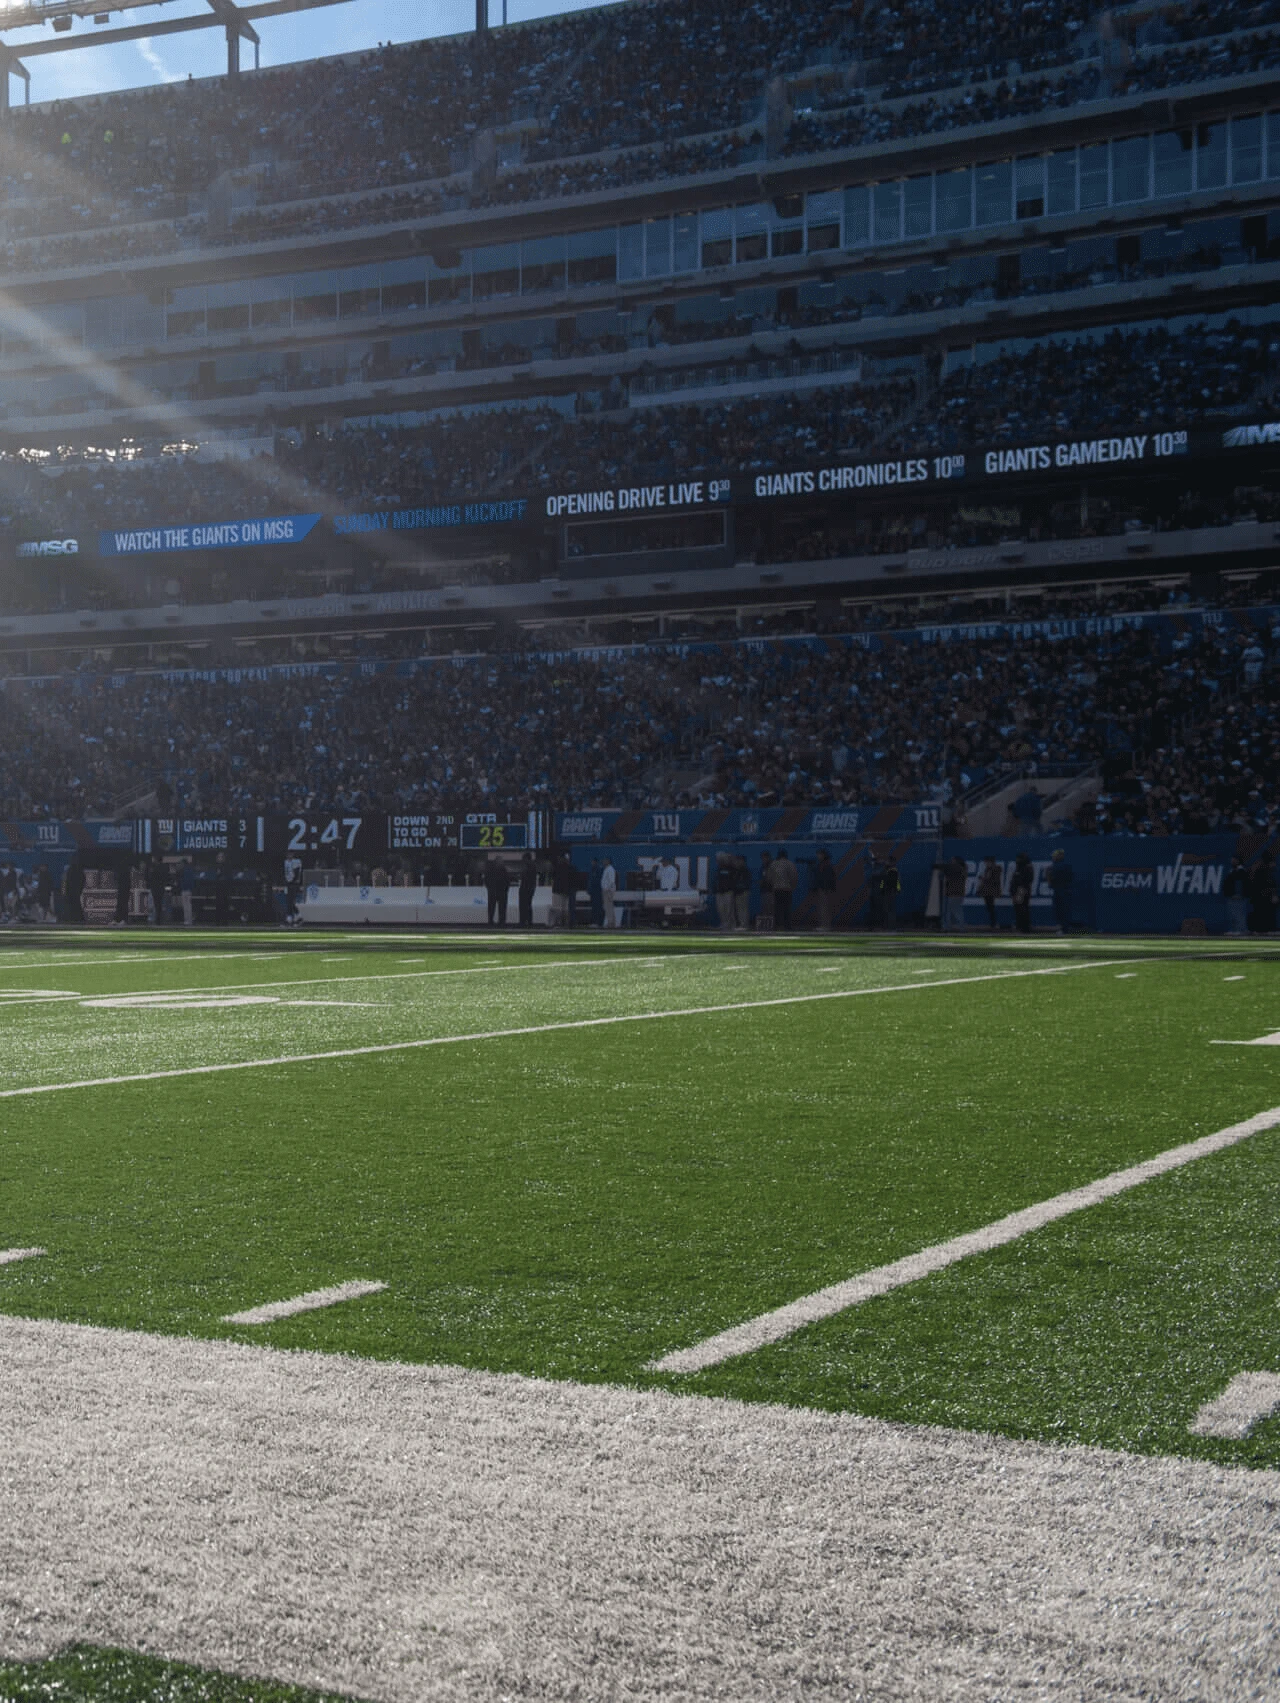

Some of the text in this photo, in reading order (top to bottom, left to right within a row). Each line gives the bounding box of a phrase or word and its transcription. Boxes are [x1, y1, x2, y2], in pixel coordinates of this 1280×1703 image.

[985, 446, 1050, 473] GIANTS
[1056, 435, 1148, 467] GAMEDAY
[755, 472, 814, 497] GIANTS
[819, 459, 928, 490] CHRONICLES
[547, 490, 614, 515] OPENING
[619, 486, 666, 509] DRIVE
[669, 482, 703, 504] LIVE
[333, 500, 528, 535] SUNDAY MORNING KICKOFF
[114, 520, 294, 551] WATCH THE GIANTS ON MSG
[30, 539, 78, 556] MSG
[183, 819, 247, 833] GIANTS 3
[393, 816, 429, 826] DOWN
[465, 813, 497, 824] QTR
[811, 812, 858, 830] GIANTS
[183, 835, 247, 848] JAGUARS 7
[288, 817, 362, 850] 2:47
[393, 827, 408, 837] TO
[410, 827, 428, 837] GO
[478, 826, 505, 847] 25
[393, 838, 422, 848] BALL
[424, 838, 442, 848] ON
[1157, 853, 1224, 893] WFAN
